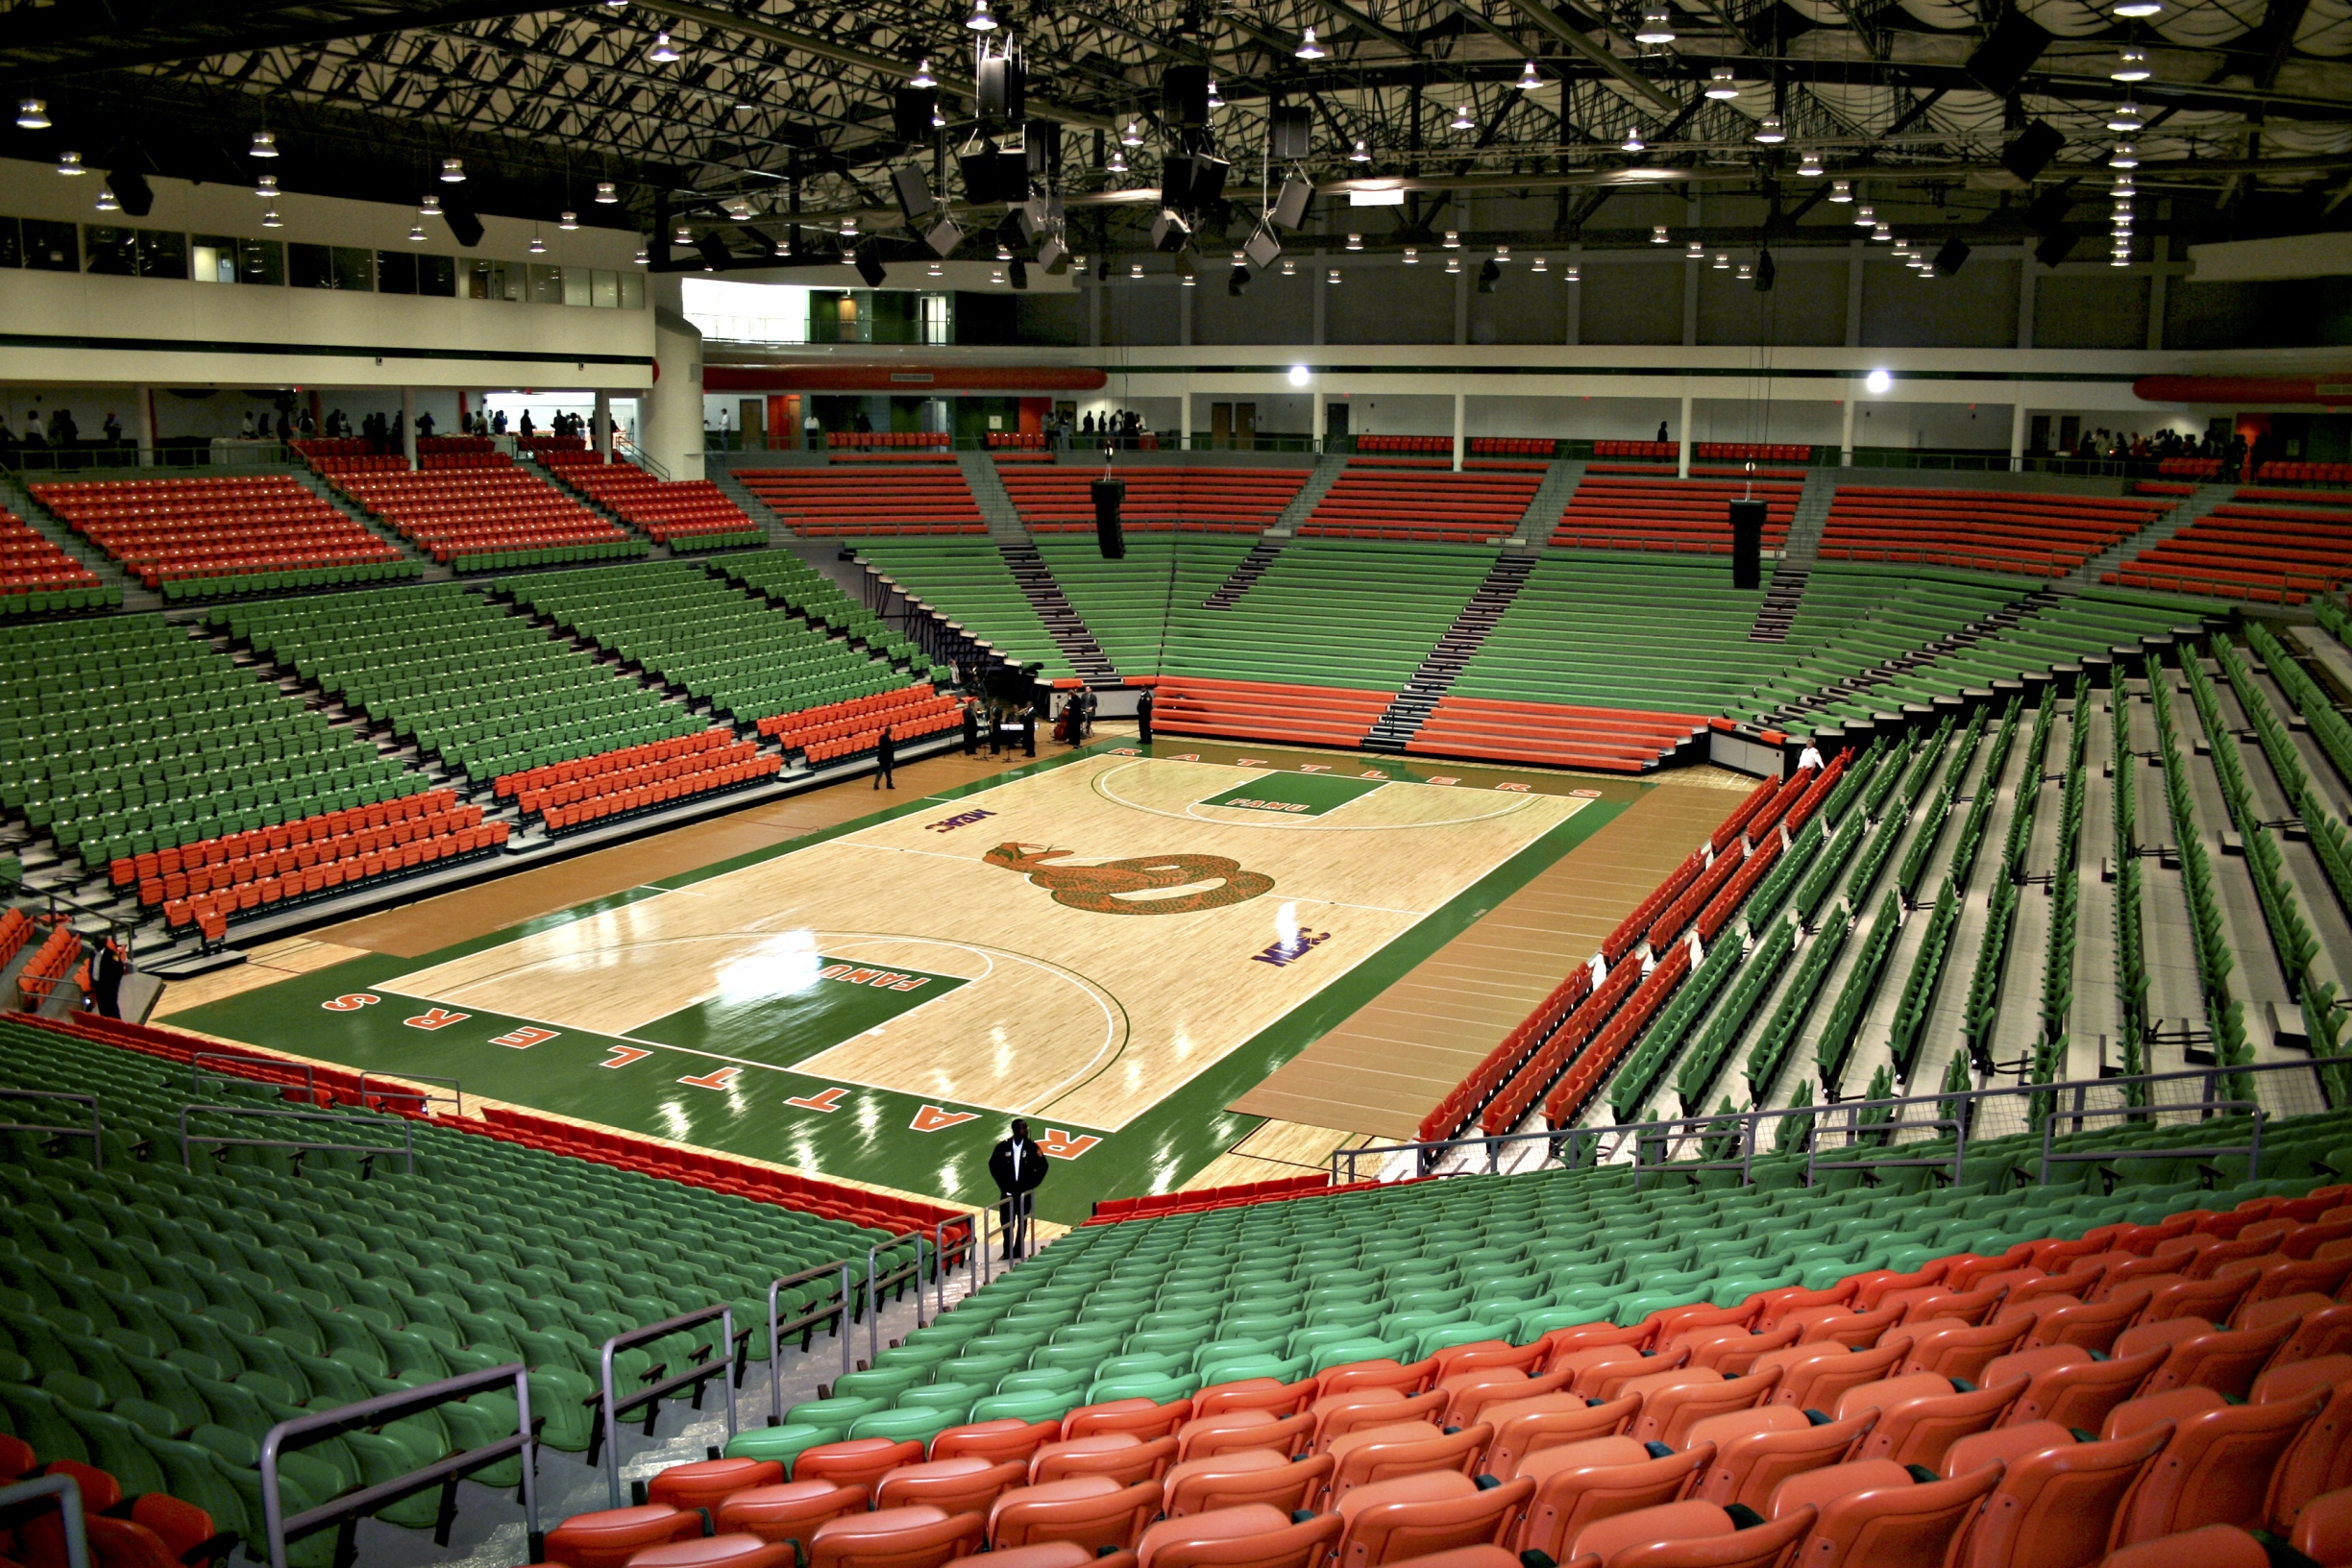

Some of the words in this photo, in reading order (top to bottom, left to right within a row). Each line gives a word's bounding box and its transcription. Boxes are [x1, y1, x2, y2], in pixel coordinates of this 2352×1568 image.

[1108, 747, 1603, 797] RATTLERS
[1225, 797, 1311, 812] FAMU
[925, 808, 997, 833] MEAC
[820, 964, 932, 992] FAMU
[322, 992, 1103, 1162] RATTLERS
